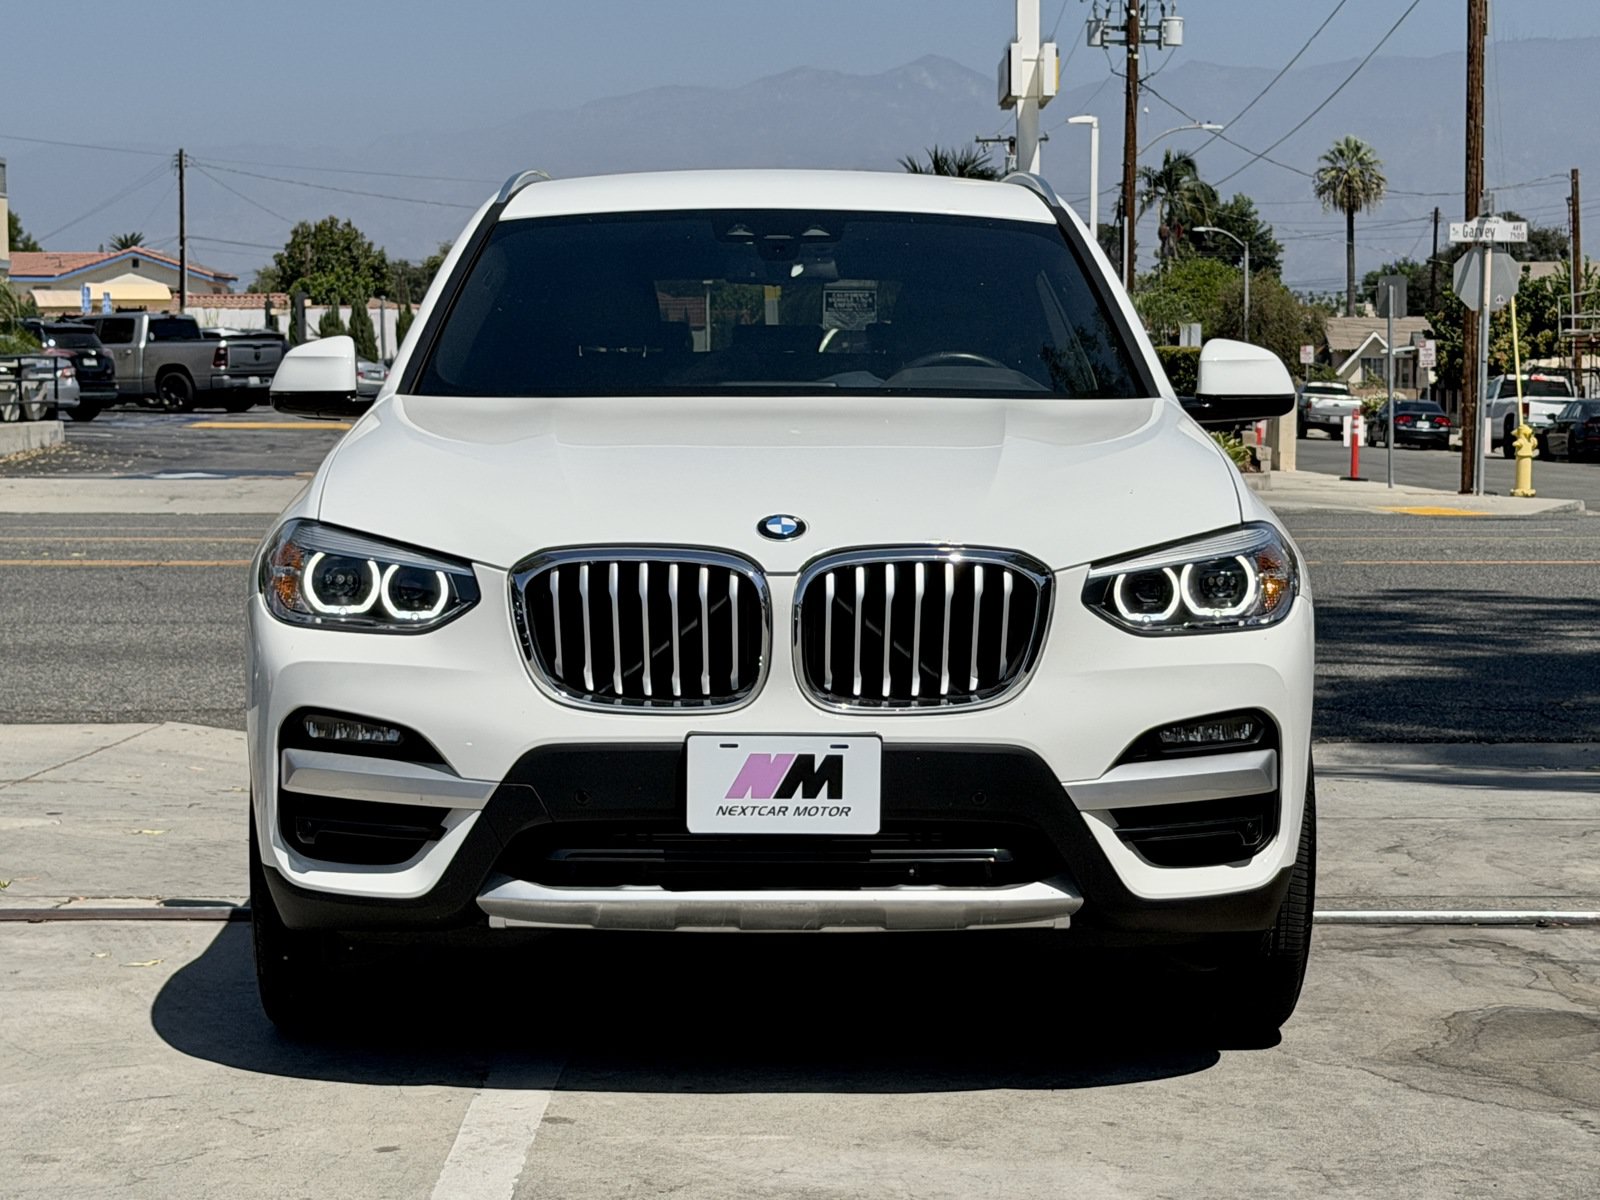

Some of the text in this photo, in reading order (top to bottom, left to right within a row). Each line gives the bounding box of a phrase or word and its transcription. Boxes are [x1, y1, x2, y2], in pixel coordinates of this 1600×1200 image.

[1462, 223, 1496, 240] Garvey
[716, 805, 852, 817] NEXTCAR MOTOR
